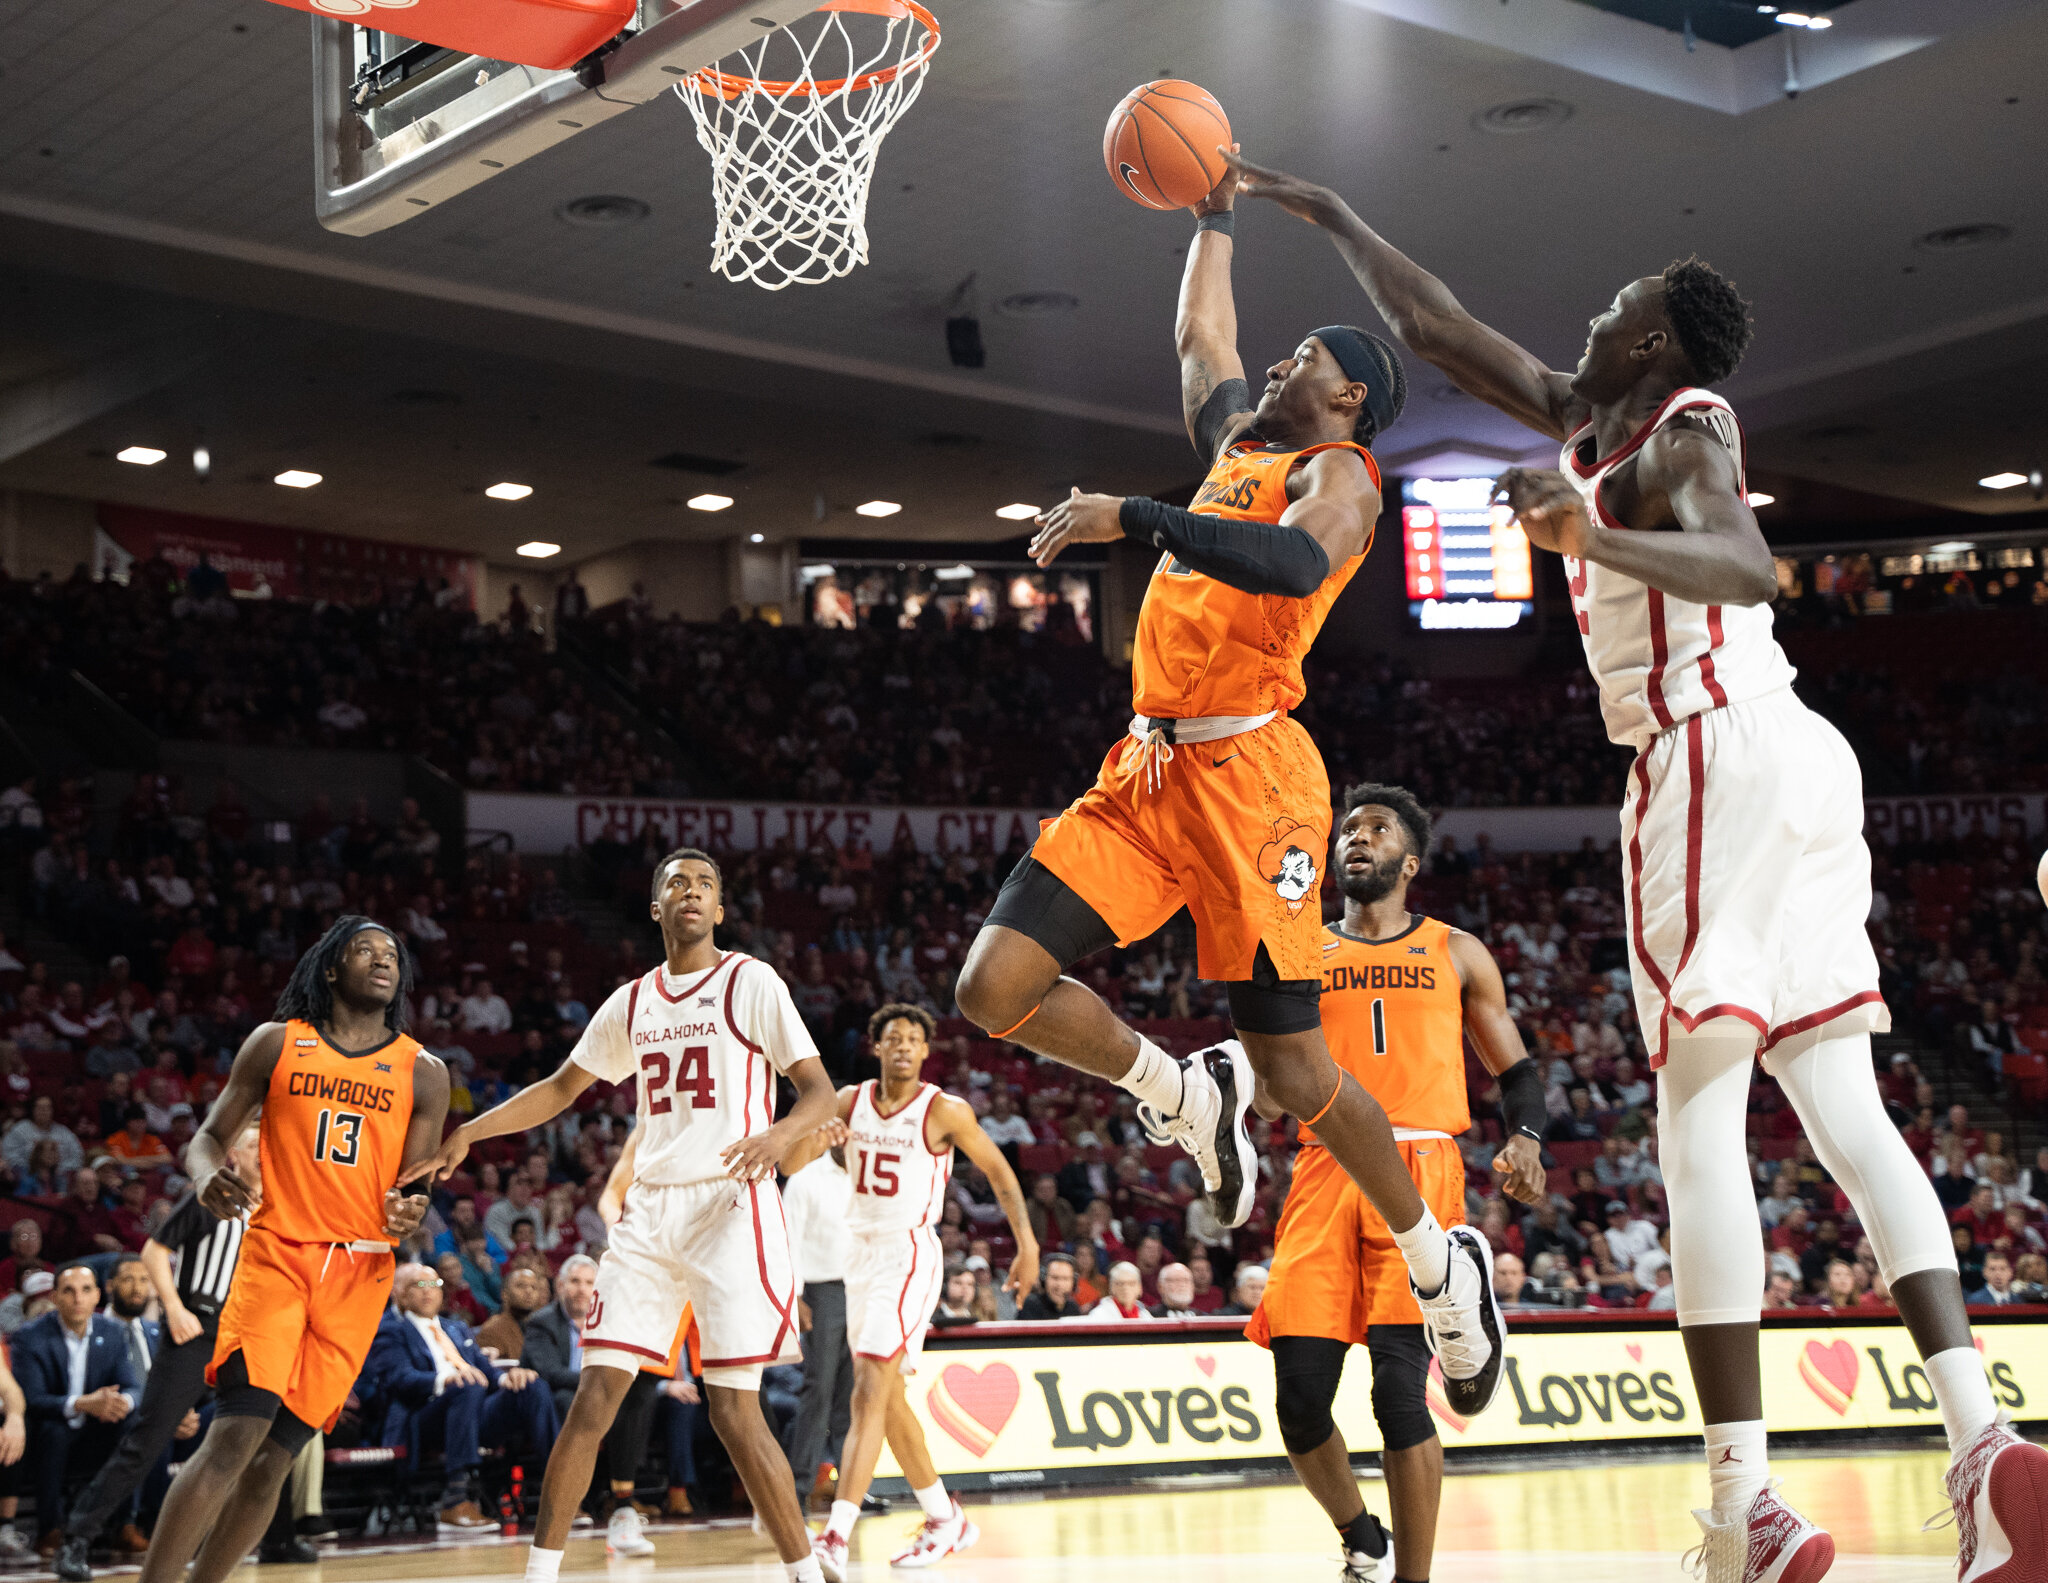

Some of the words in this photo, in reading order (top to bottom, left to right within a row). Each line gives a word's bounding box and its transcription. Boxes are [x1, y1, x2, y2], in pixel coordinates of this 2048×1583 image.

[936, 812, 1047, 854] CHA
[635, 1022, 718, 1046] OKLAHOMA
[1371, 998, 1387, 1055] 1
[289, 1071, 395, 1113] COWBOYS
[640, 1045, 716, 1117] 24
[314, 1108, 366, 1167] 13
[856, 1149, 901, 1197] 15
